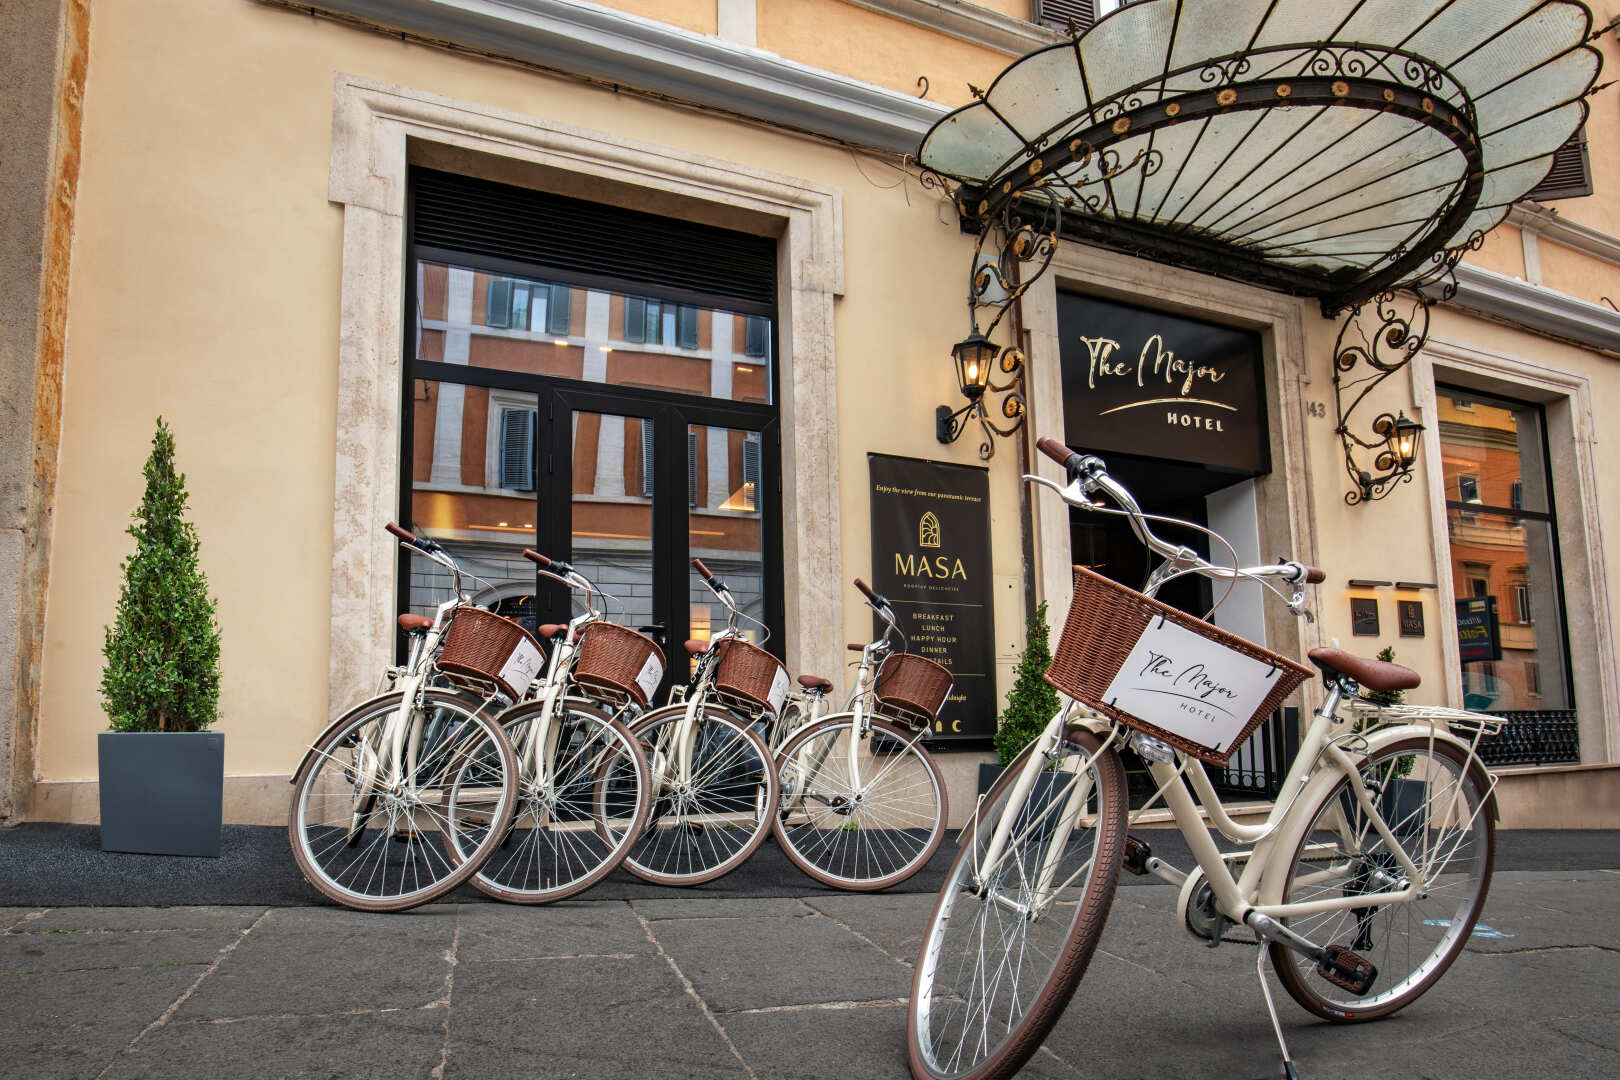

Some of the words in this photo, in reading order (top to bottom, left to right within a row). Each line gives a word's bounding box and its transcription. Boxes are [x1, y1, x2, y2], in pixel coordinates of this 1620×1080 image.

[1079, 335, 1132, 389] The
[1138, 334, 1225, 396] Major
[1167, 412, 1224, 432] HOTEL
[876, 484, 892, 494] Enjoy
[913, 488, 927, 497] from
[895, 553, 967, 580] MASA
[912, 613, 954, 621] BREAKFAST
[910, 635, 934, 643] HAPPY
[1139, 650, 1173, 677] The
[1173, 663, 1239, 699] Major
[1180, 702, 1217, 723] HOTEL
